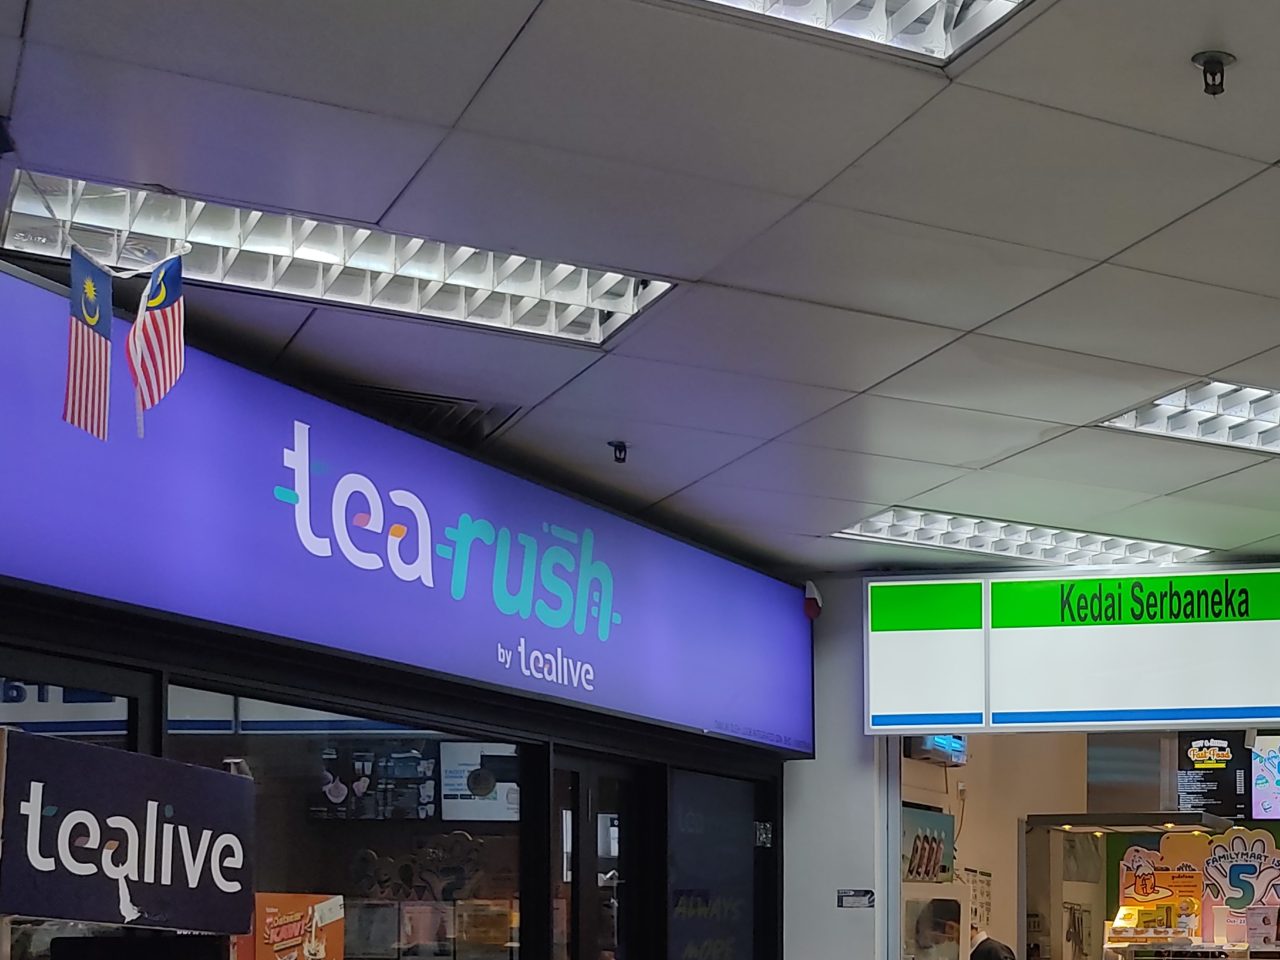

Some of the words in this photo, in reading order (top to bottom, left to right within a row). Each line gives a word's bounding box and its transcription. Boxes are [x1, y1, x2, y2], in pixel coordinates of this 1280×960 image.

[1060, 583, 1123, 623] Kedai
[1130, 578, 1250, 622] Serbaneka
[498, 643, 512, 669] by
[518, 637, 595, 692] tealive
[19, 779, 244, 894] tealive
[1206, 851, 1269, 868] FAMILYMART
[1225, 863, 1257, 910] 5
